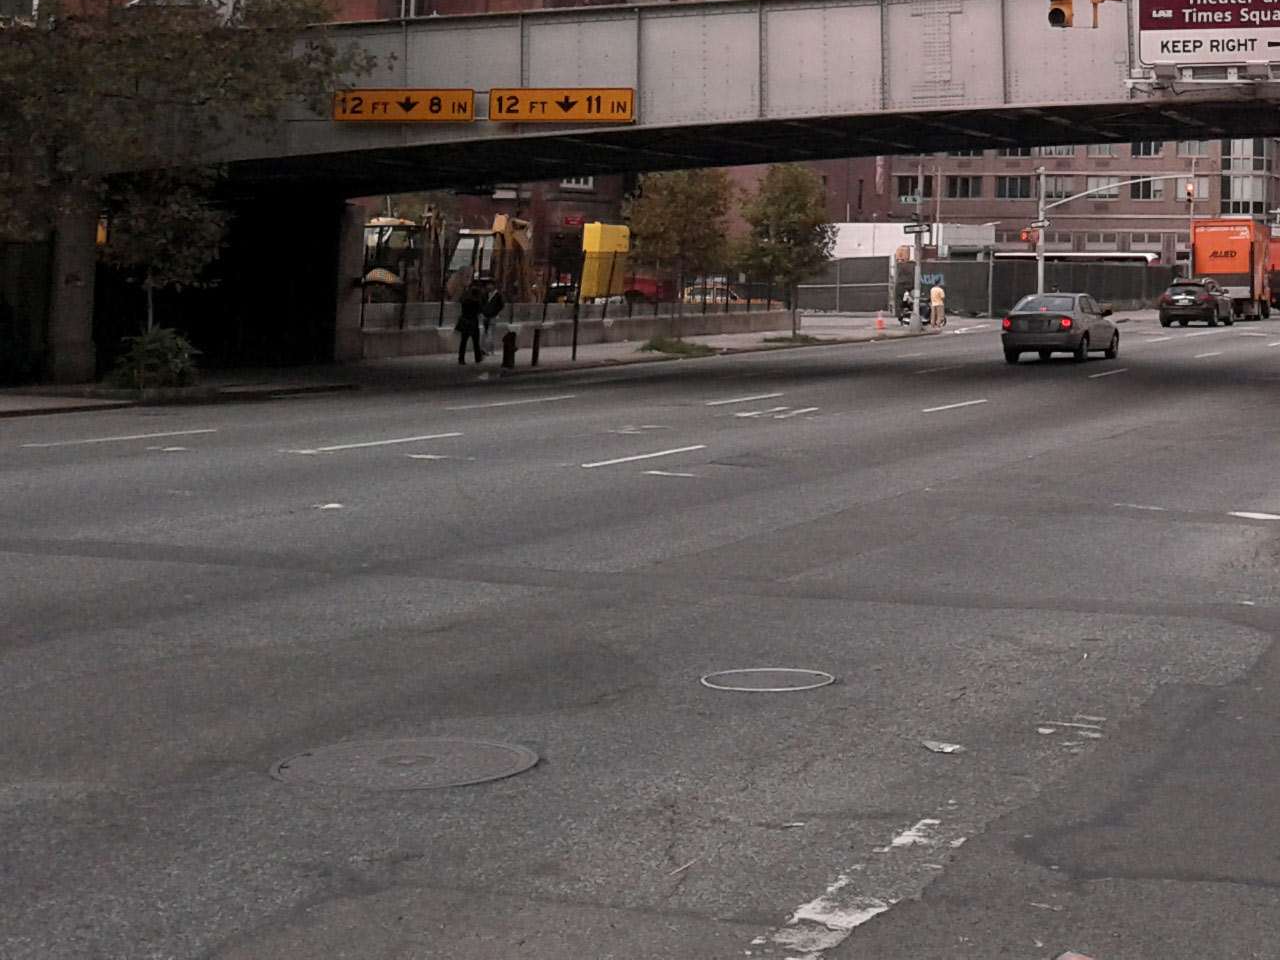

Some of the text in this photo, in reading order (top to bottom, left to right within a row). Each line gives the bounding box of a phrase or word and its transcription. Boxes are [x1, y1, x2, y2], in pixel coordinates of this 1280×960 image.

[1182, 8, 1232, 23] Times
[1160, 39, 1258, 53] KEEP RIGHT
[340, 96, 467, 114] 12 FT 8 IN
[496, 95, 627, 114] 12 FT 11 IN
[1208, 250, 1237, 258] ALLIED
